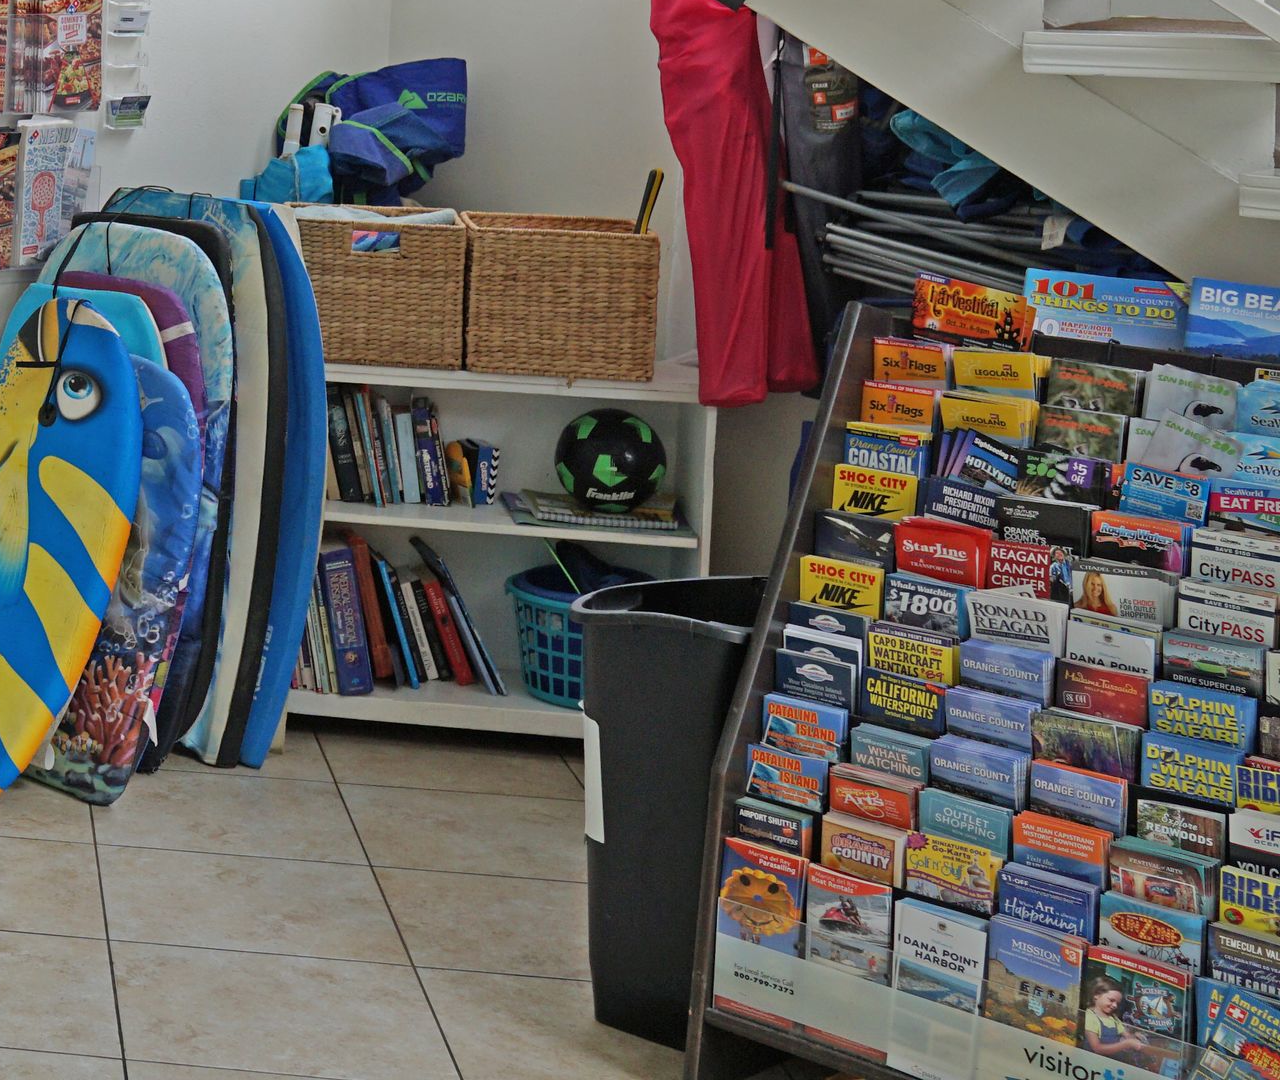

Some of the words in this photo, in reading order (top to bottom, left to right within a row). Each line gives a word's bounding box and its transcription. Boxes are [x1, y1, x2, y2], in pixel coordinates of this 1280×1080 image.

[1035, 278, 1095, 300] 101
[1200, 287, 1239, 306] BIG
[1032, 294, 1108, 313] THINGS
[1113, 303, 1140, 315] TO
[1144, 306, 1175, 319] DO
[883, 357, 900, 368] Six
[909, 360, 937, 373] Flags
[974, 369, 1019, 379] LEGOLAND
[870, 400, 887, 412] Six
[895, 403, 924, 418] Flags
[961, 415, 1007, 427] LEGOLAND
[848, 448, 915, 475] COASTAL
[1073, 461, 1088, 476] $5
[839, 470, 875, 484] SHOE
[880, 476, 908, 490] CITY
[1133, 468, 1175, 490] SAVE
[1185, 480, 1200, 497] $8
[586, 488, 634, 500] Franklin
[847, 490, 891, 511] NIKE
[942, 485, 973, 501] RICHARD
[973, 494, 995, 508] NIXON
[1220, 496, 1251, 511] EAT
[1225, 487, 1264, 497] SeaWorld
[932, 502, 960, 518] LIBRARY
[968, 512, 999, 527] MUSEUM
[944, 496, 990, 516] PRESIDENTIAL
[1004, 526, 1040, 536] ORANGE
[1101, 522, 1137, 541] Raging
[1138, 529, 1174, 546] Waters
[991, 547, 1049, 566] REAGAN
[809, 562, 845, 578] SHOE
[850, 570, 876, 586] CITY
[993, 561, 1045, 579] RANCH
[1080, 564, 1110, 573] CITADEL
[1112, 567, 1149, 577] OUTLETS
[1199, 563, 1275, 589] CityPASS
[819, 583, 860, 605] NIKE
[890, 580, 917, 591] Whale
[917, 584, 957, 600] Watching
[971, 601, 1046, 623] RONALD
[1120, 610, 1157, 620] SHOPPING
[974, 616, 1050, 638] REAGAN
[1188, 615, 1265, 643] CityPASS
[873, 634, 897, 648] CAPO
[899, 639, 928, 655] BEACH
[873, 646, 942, 670] WATERCRAFT
[873, 658, 919, 678] RENTALS
[1069, 652, 1106, 666] DANA
[1110, 660, 1149, 675] POINT
[963, 658, 1000, 673] ORANGE
[1002, 665, 1040, 682] COUNTY
[1064, 668, 1101, 688] Madame
[866, 677, 939, 709] CALIFORNIA
[1172, 673, 1197, 685] DRIVE
[1198, 678, 1247, 695] SUPERCARS
[767, 702, 819, 725] CATALINA
[869, 694, 934, 720] WATERSPORTS
[1151, 691, 1235, 717] DOLPHIN
[949, 707, 986, 723] ORANGE
[988, 714, 1026, 732] COUNTY
[1164, 706, 1239, 731] WHALE
[796, 722, 836, 743] ISLAND
[1156, 718, 1239, 745] SAFARI
[751, 748, 802, 773] CATALINA
[855, 752, 922, 777] WATCHING
[867, 745, 909, 764] WHALE
[1146, 743, 1231, 776] DOLPHIN
[779, 769, 820, 791] ISLAND
[933, 756, 971, 774] ORANGE
[973, 765, 1011, 784] COUNTY
[1159, 761, 1234, 789] WHALE
[1033, 778, 1074, 797] ORANGE
[1076, 789, 1117, 808] COUNTY
[1149, 774, 1233, 804] SAFARI
[739, 808, 768, 824] AIRPORT
[768, 815, 798, 831] SHUTTLE
[935, 812, 997, 841] SHOPPING
[943, 807, 990, 829] OUTLET
[1161, 812, 1199, 832] Explore
[1022, 829, 1051, 843] HISTORIC
[1051, 834, 1094, 853] DOWNTOWN
[1145, 821, 1214, 847] REDWOODS
[831, 845, 890, 871] COUNTY
[931, 844, 972, 860] Go-Karts
[758, 858, 797, 876] Parasailing
[1003, 895, 1084, 934] Happening!
[1035, 900, 1055, 915] Art
[902, 937, 939, 955] DANA
[942, 949, 980, 969] POINT
[1010, 937, 1061, 964] MISSION
[1218, 934, 1263, 957] TEMECULA
[914, 950, 966, 975] HARBOR
[733, 971, 795, 996] 800-799-7373
[1023, 1046, 1102, 1080] visitor
